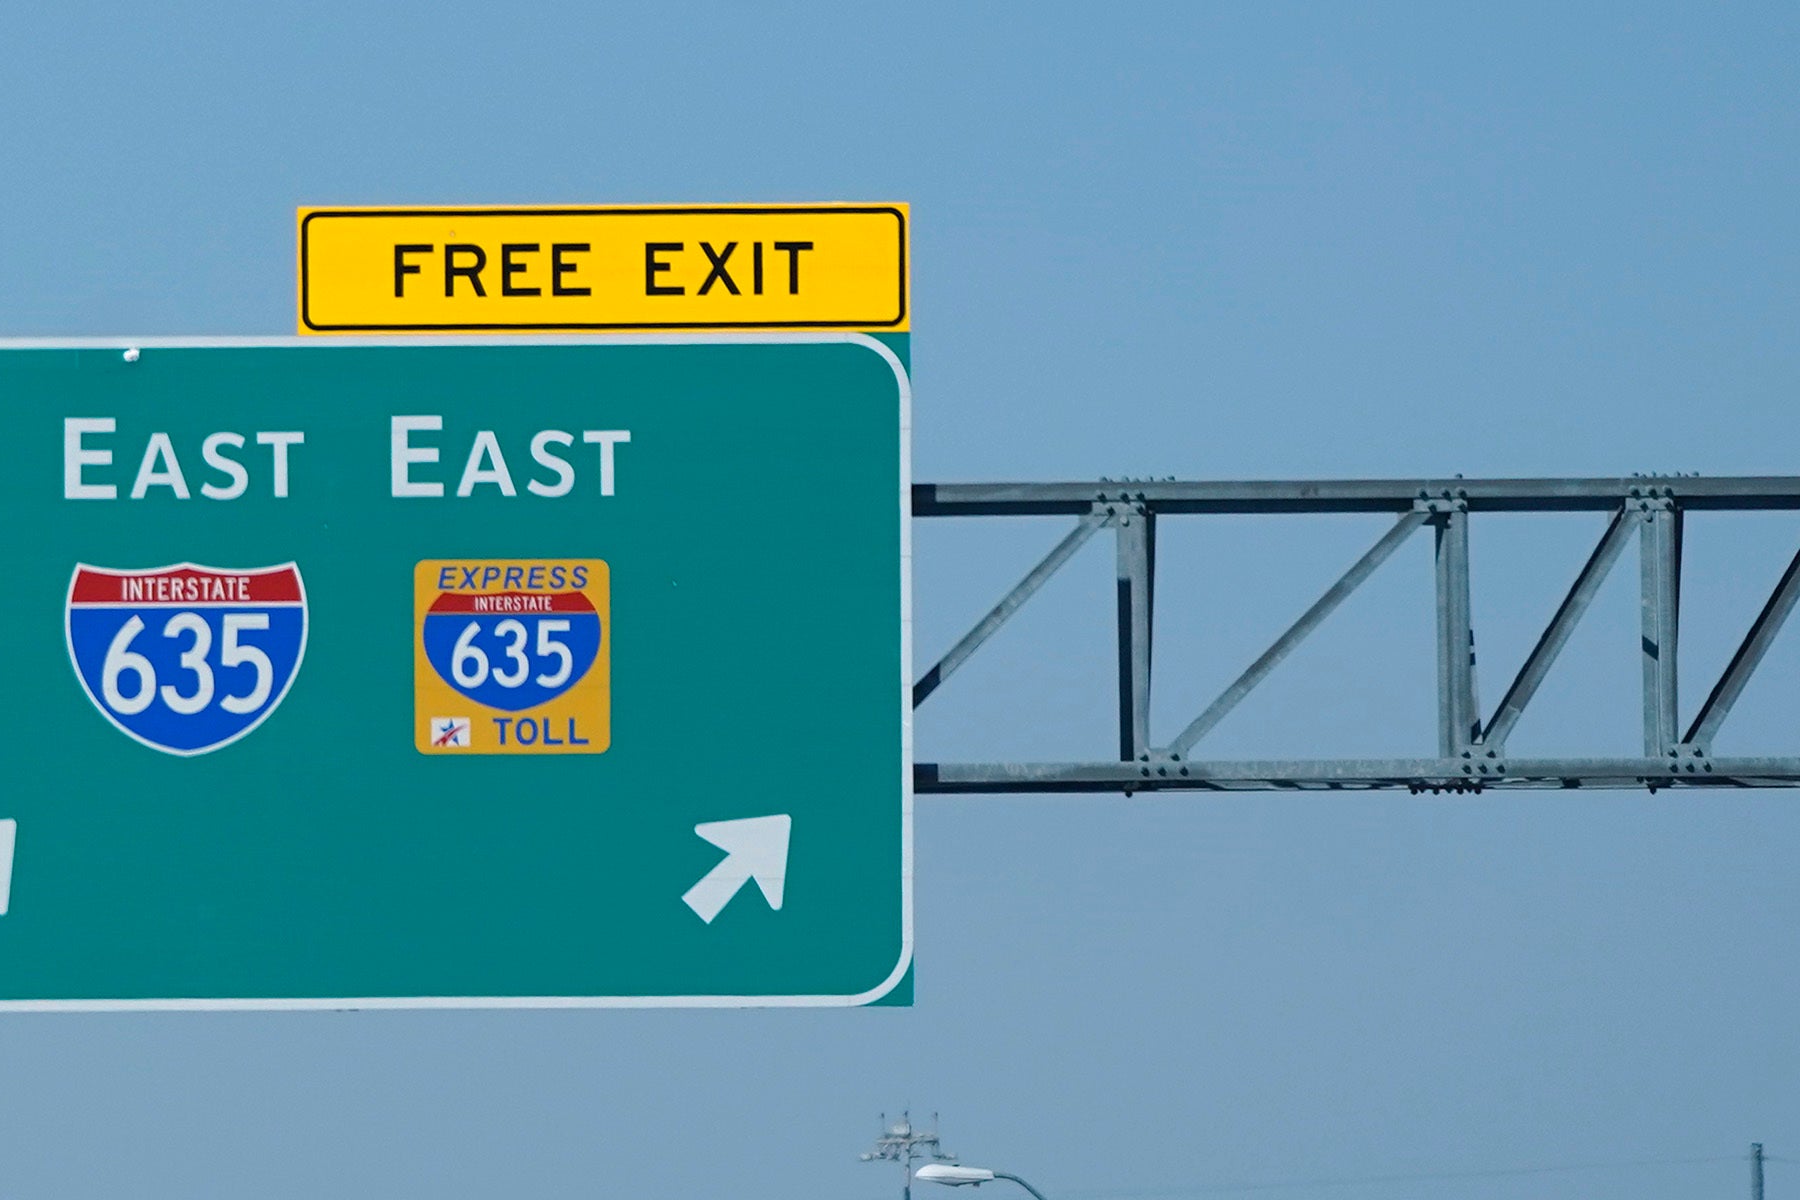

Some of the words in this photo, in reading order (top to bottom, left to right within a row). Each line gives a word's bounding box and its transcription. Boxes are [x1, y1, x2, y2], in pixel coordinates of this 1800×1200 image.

[394, 242, 593, 299] FREE
[644, 240, 815, 297] EXIT
[63, 416, 305, 501] EAST
[390, 414, 631, 498] EAST
[121, 576, 251, 601] INTERSTATE
[437, 565, 589, 590] EXPRESS
[474, 595, 553, 612] INTERSTATE
[101, 611, 274, 716] 635
[451, 618, 574, 689] 635
[492, 716, 589, 745] TOLL
